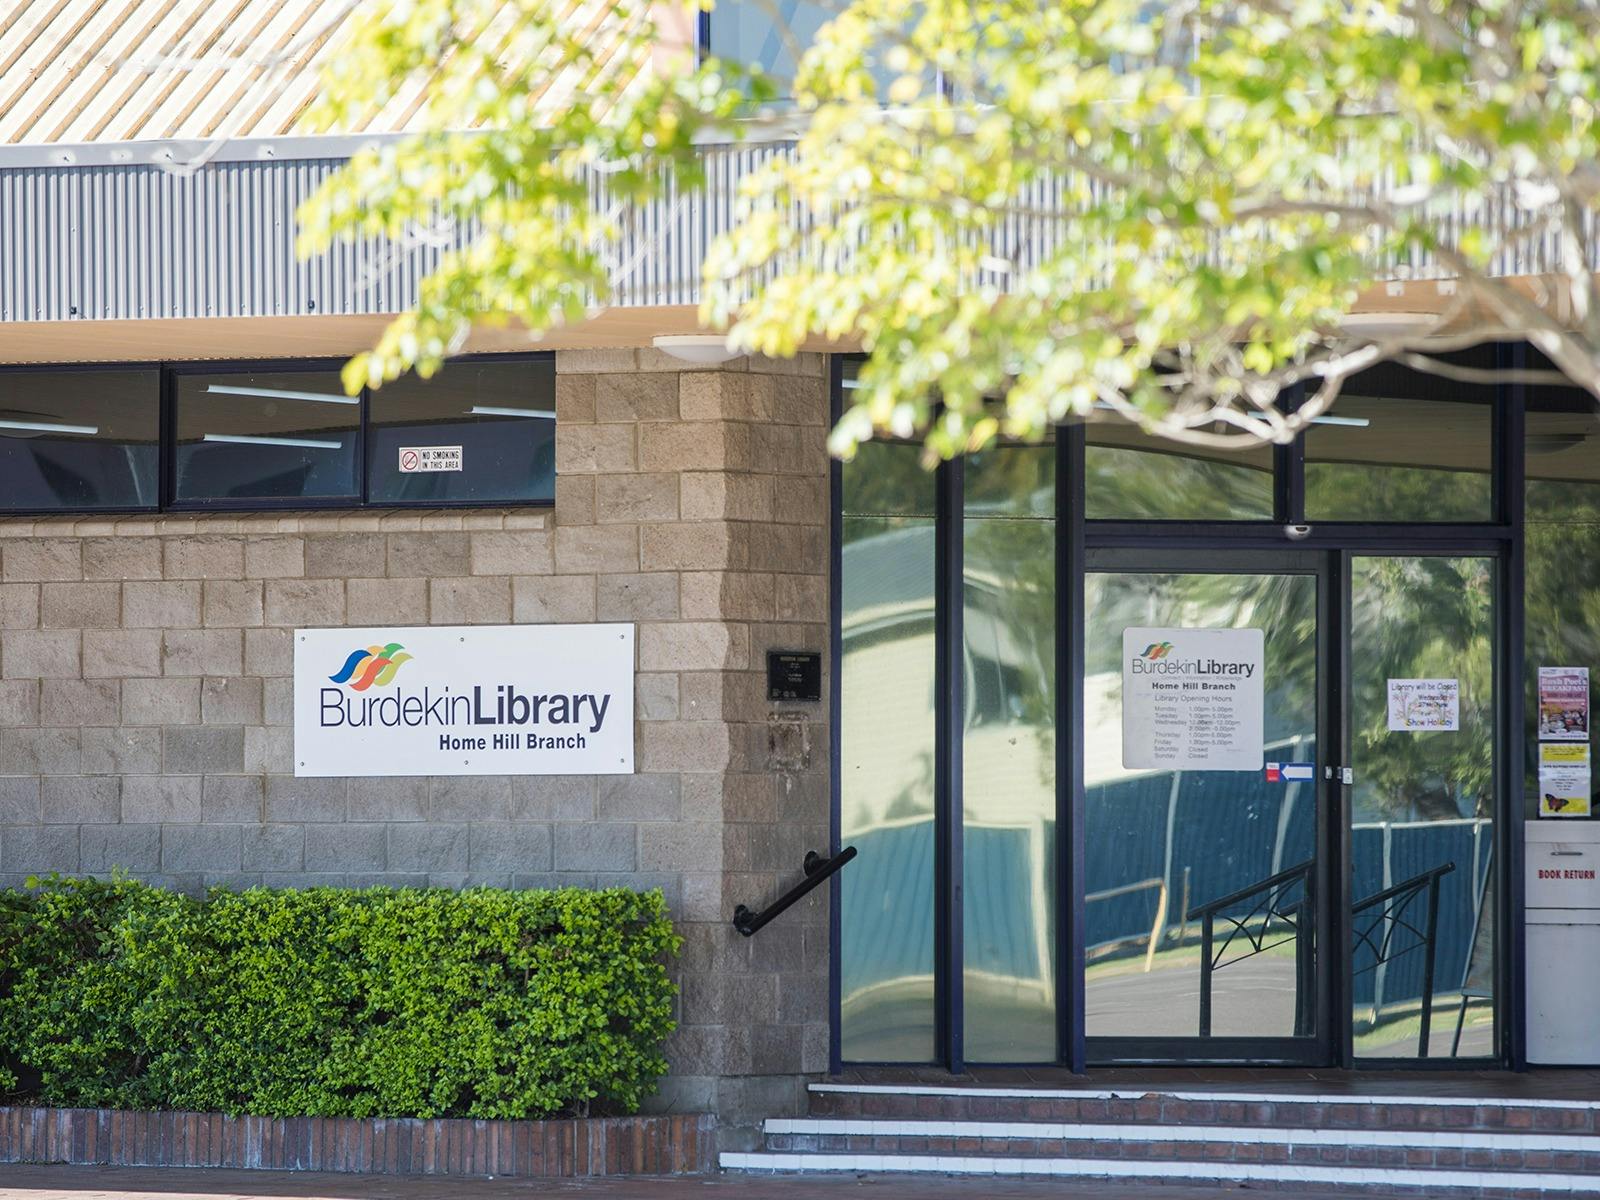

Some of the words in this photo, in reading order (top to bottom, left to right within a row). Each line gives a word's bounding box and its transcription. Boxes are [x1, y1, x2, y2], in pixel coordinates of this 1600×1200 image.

[422, 451, 430, 460] NO
[433, 450, 459, 460] SMOKING
[422, 461, 428, 469] IN
[430, 461, 443, 469] THIS
[445, 461, 459, 469] AREA
[1391, 683, 1414, 691] Library
[1154, 695, 1179, 703] Library
[1181, 695, 1210, 703] Opening
[439, 734, 486, 750] Home
[493, 734, 520, 750] Hill
[527, 733, 586, 749] Branch
[1538, 869, 1562, 880] BOOK
[1564, 869, 1596, 880] RETURN
